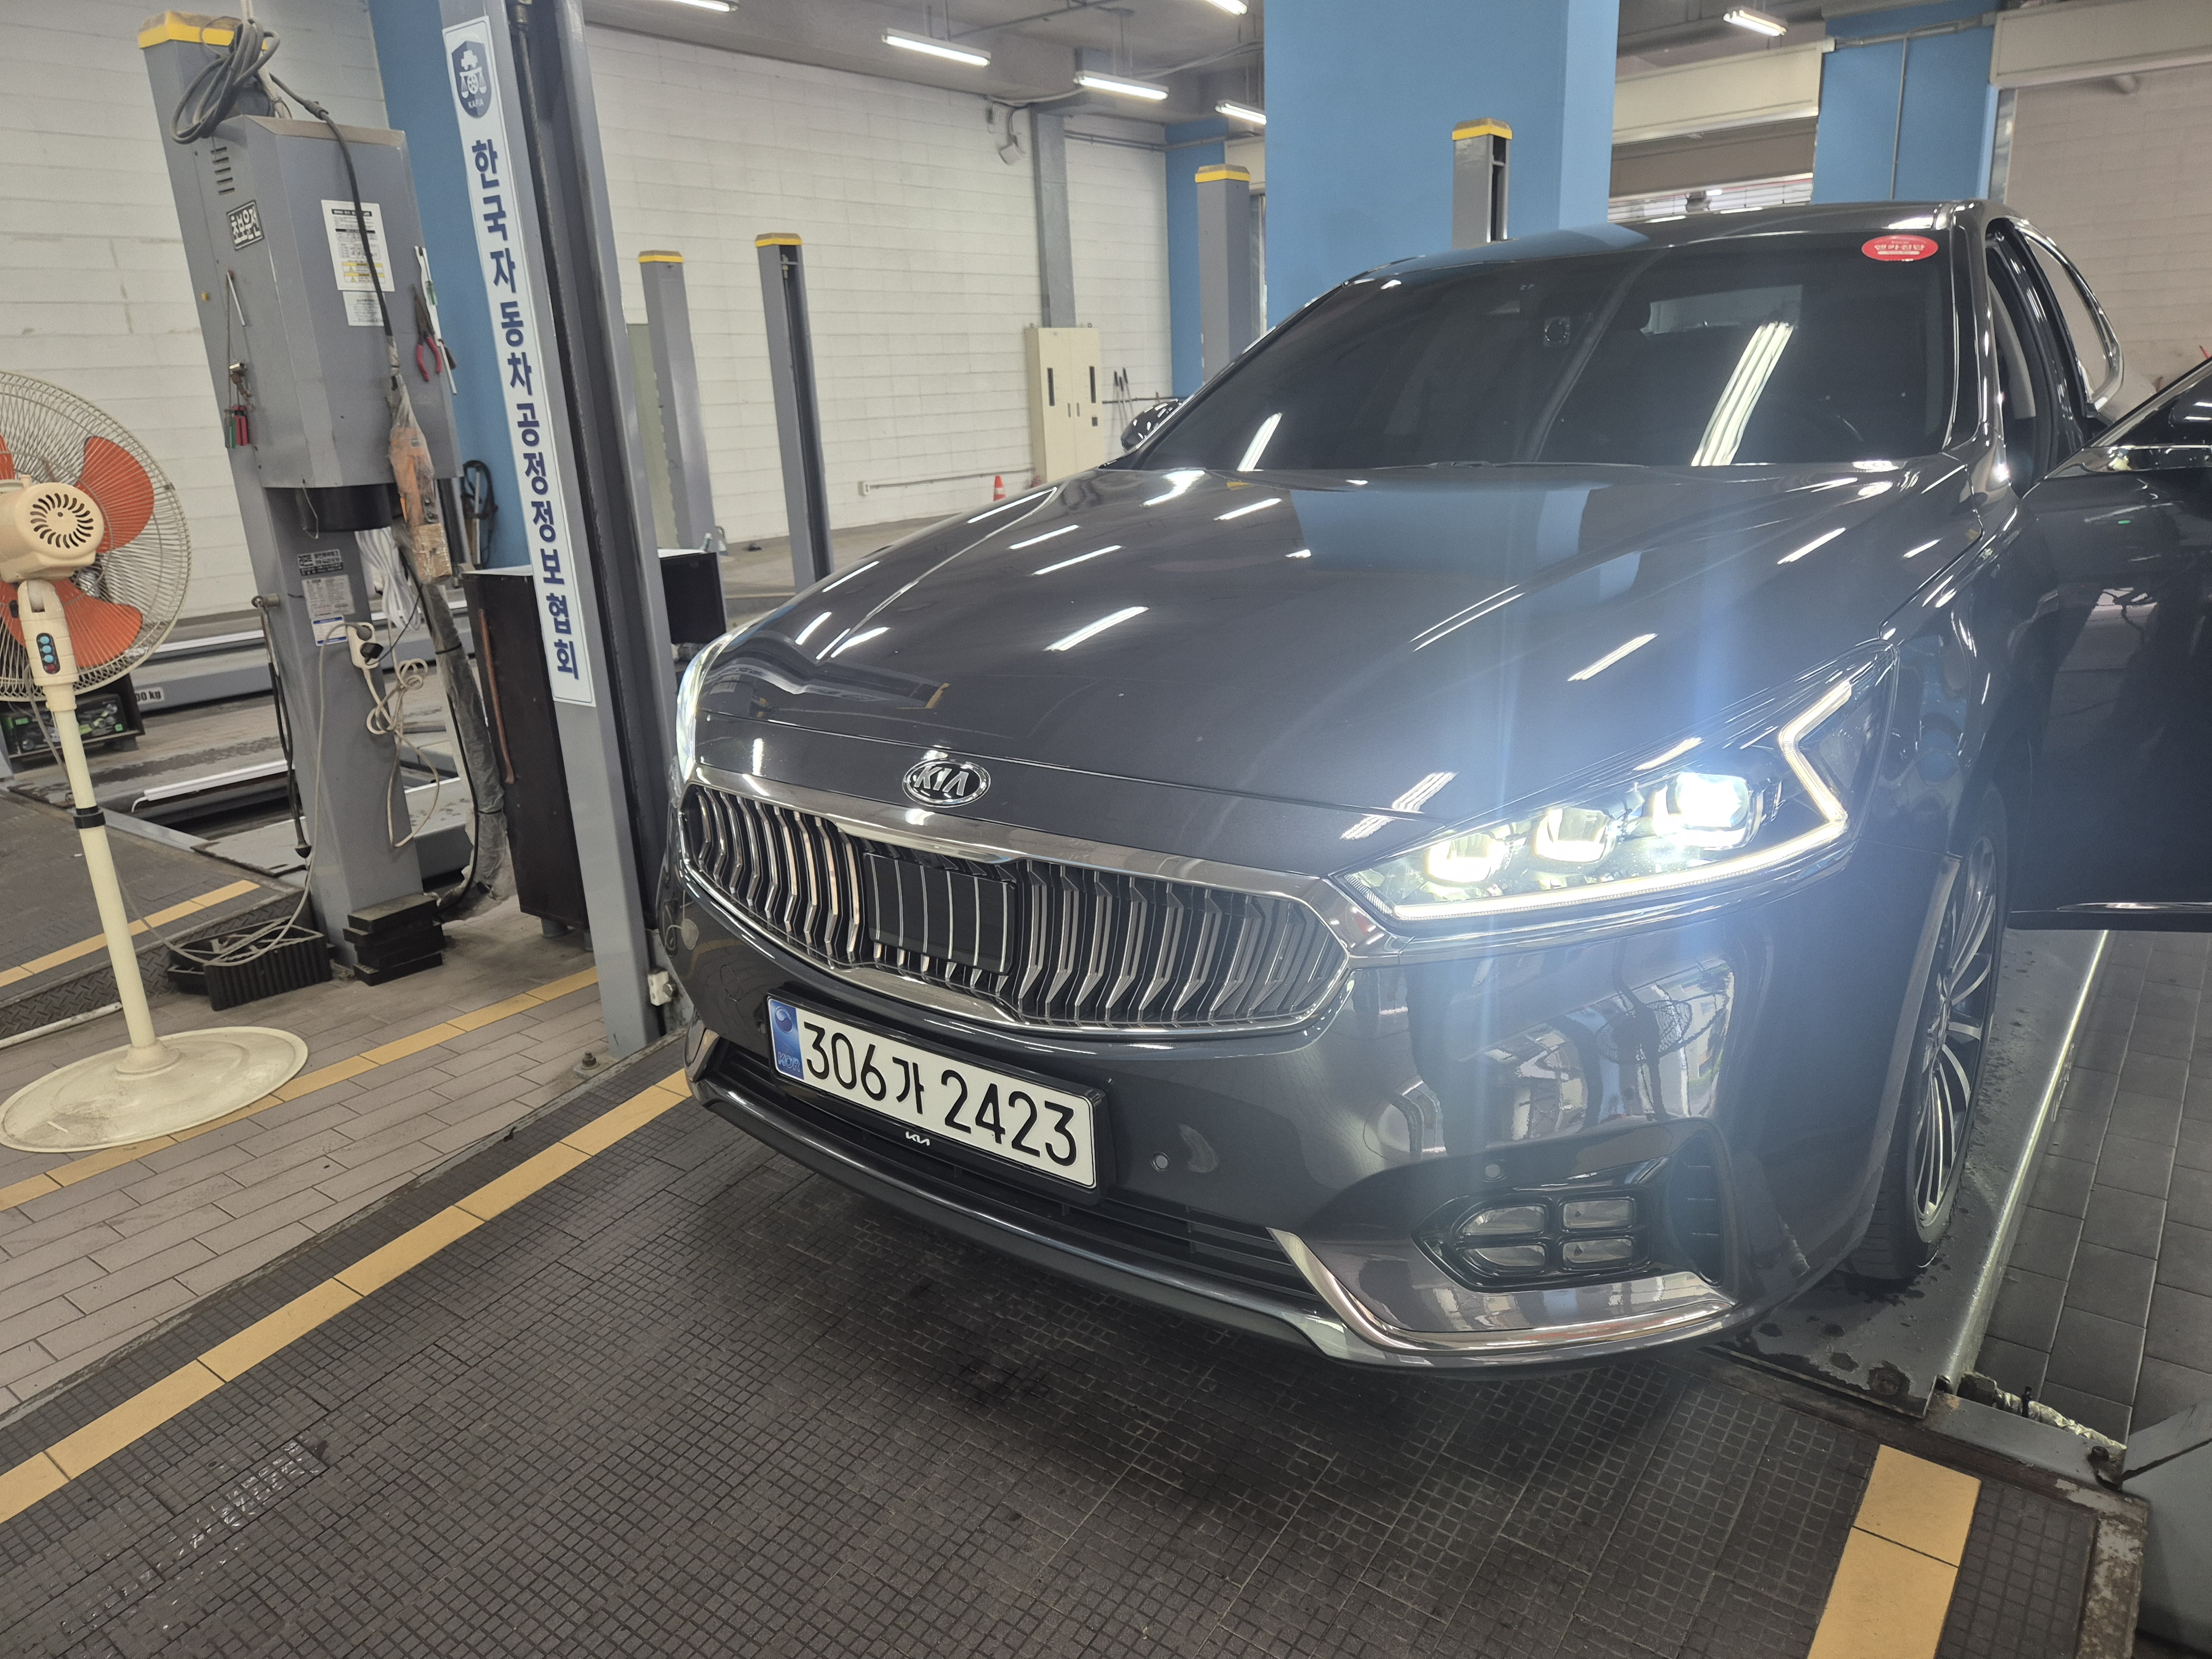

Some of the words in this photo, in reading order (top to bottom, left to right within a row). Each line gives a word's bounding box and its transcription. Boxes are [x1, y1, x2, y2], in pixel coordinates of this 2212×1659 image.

[231, 206, 261, 244] 초보운전
[472, 139, 578, 680] 한국자동차공정정보협회
[914, 765, 969, 797] KIA
[778, 1052, 800, 1072] KOR
[804, 1021, 925, 1115] 306가
[941, 1070, 1077, 1166] 2423
